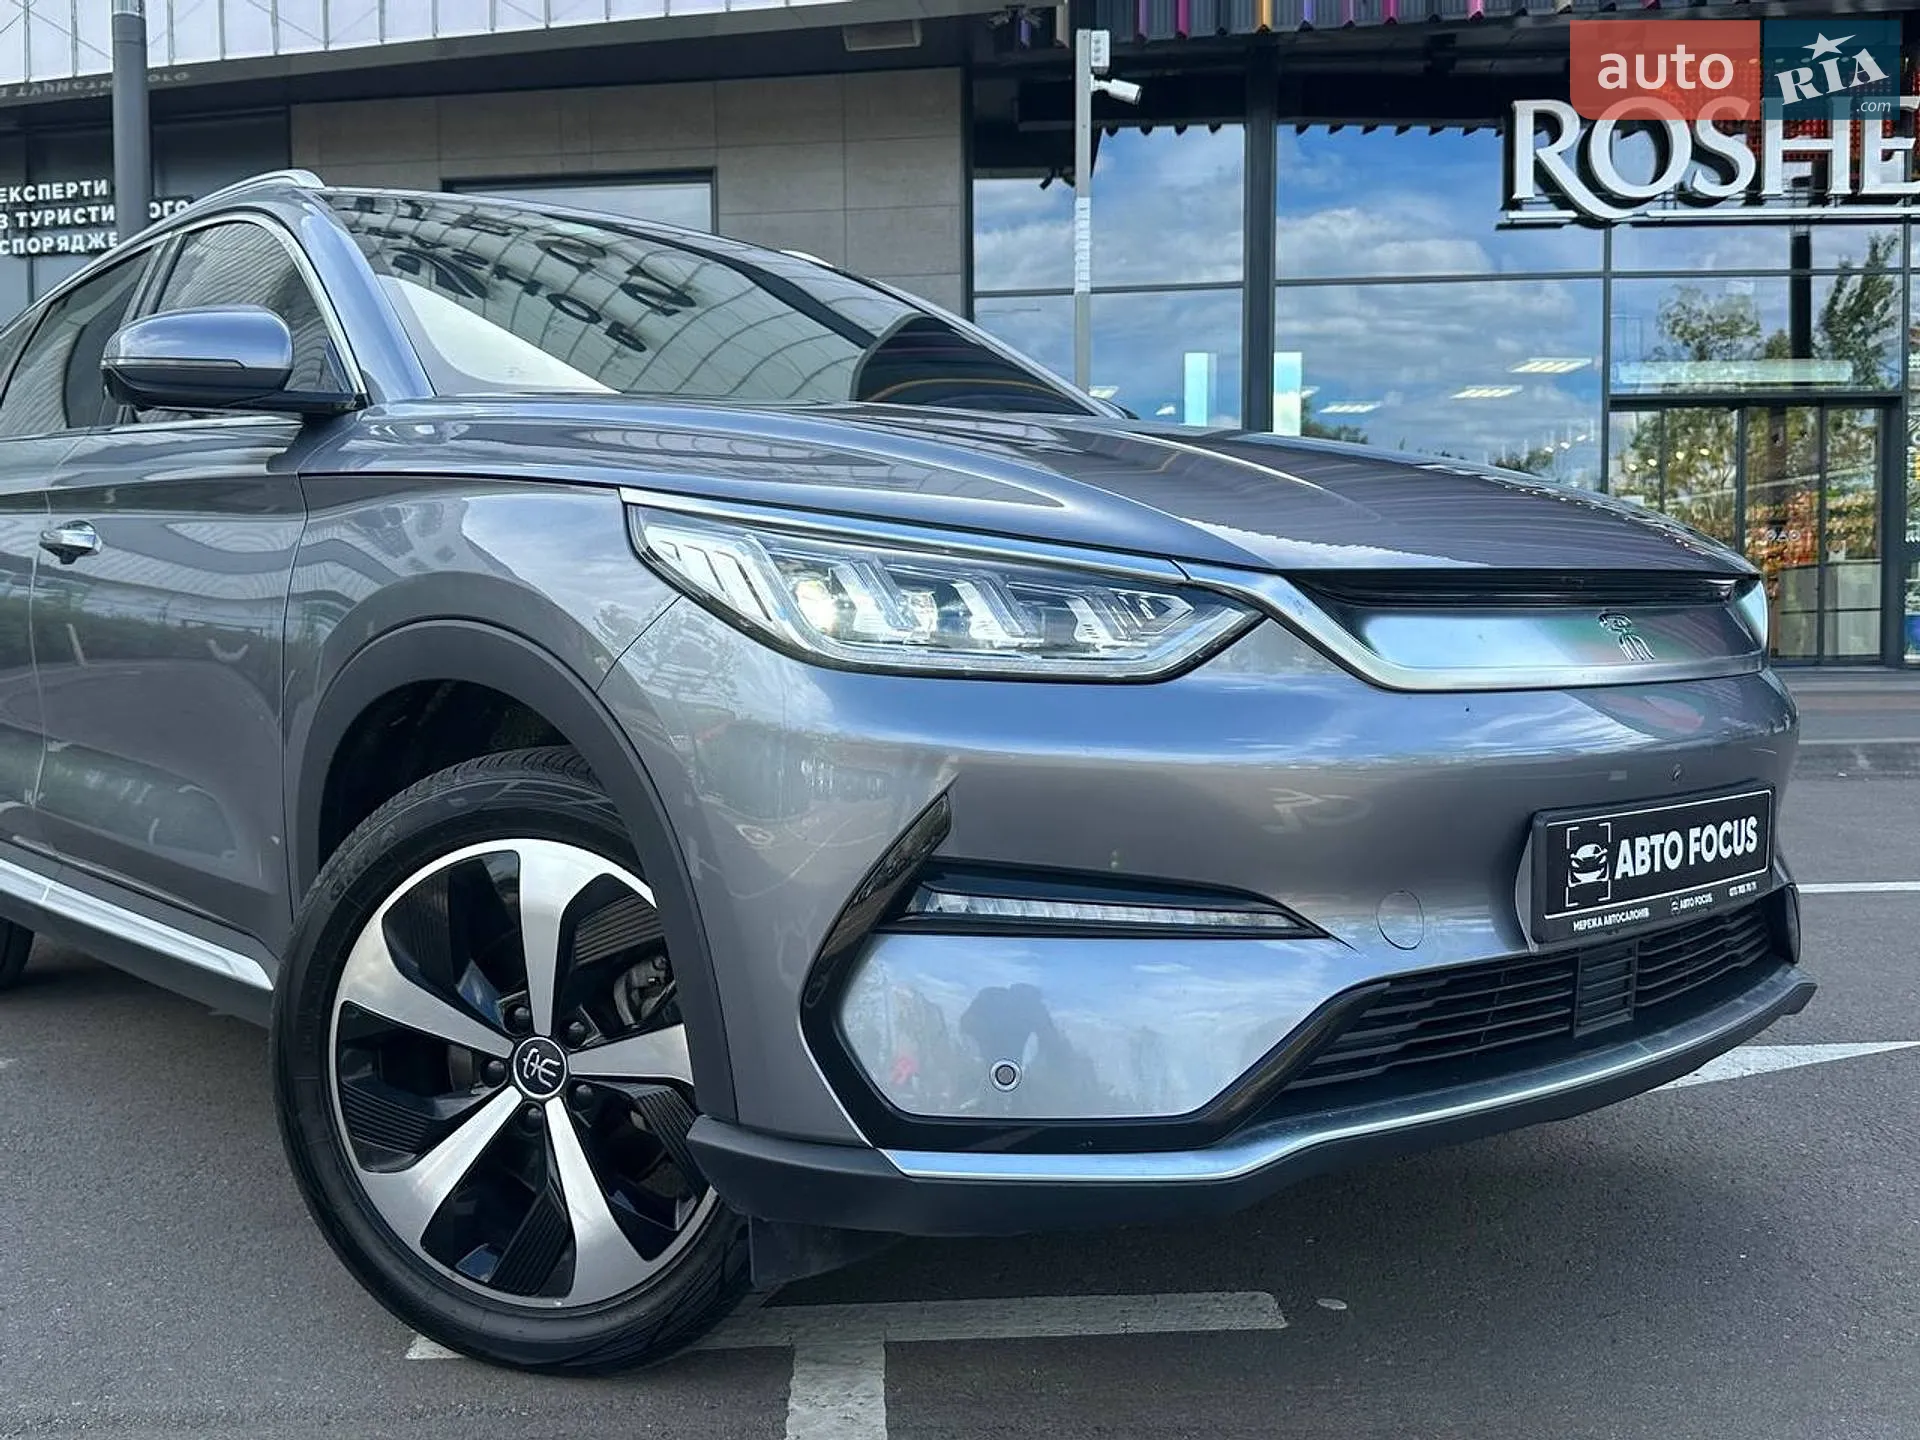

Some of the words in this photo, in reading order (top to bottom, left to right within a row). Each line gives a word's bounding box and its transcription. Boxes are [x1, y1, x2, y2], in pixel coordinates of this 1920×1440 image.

[1511, 96, 1920, 219] ROSHE
[1614, 830, 1684, 880] АВТО
[1688, 816, 1757, 866] FOCUS
